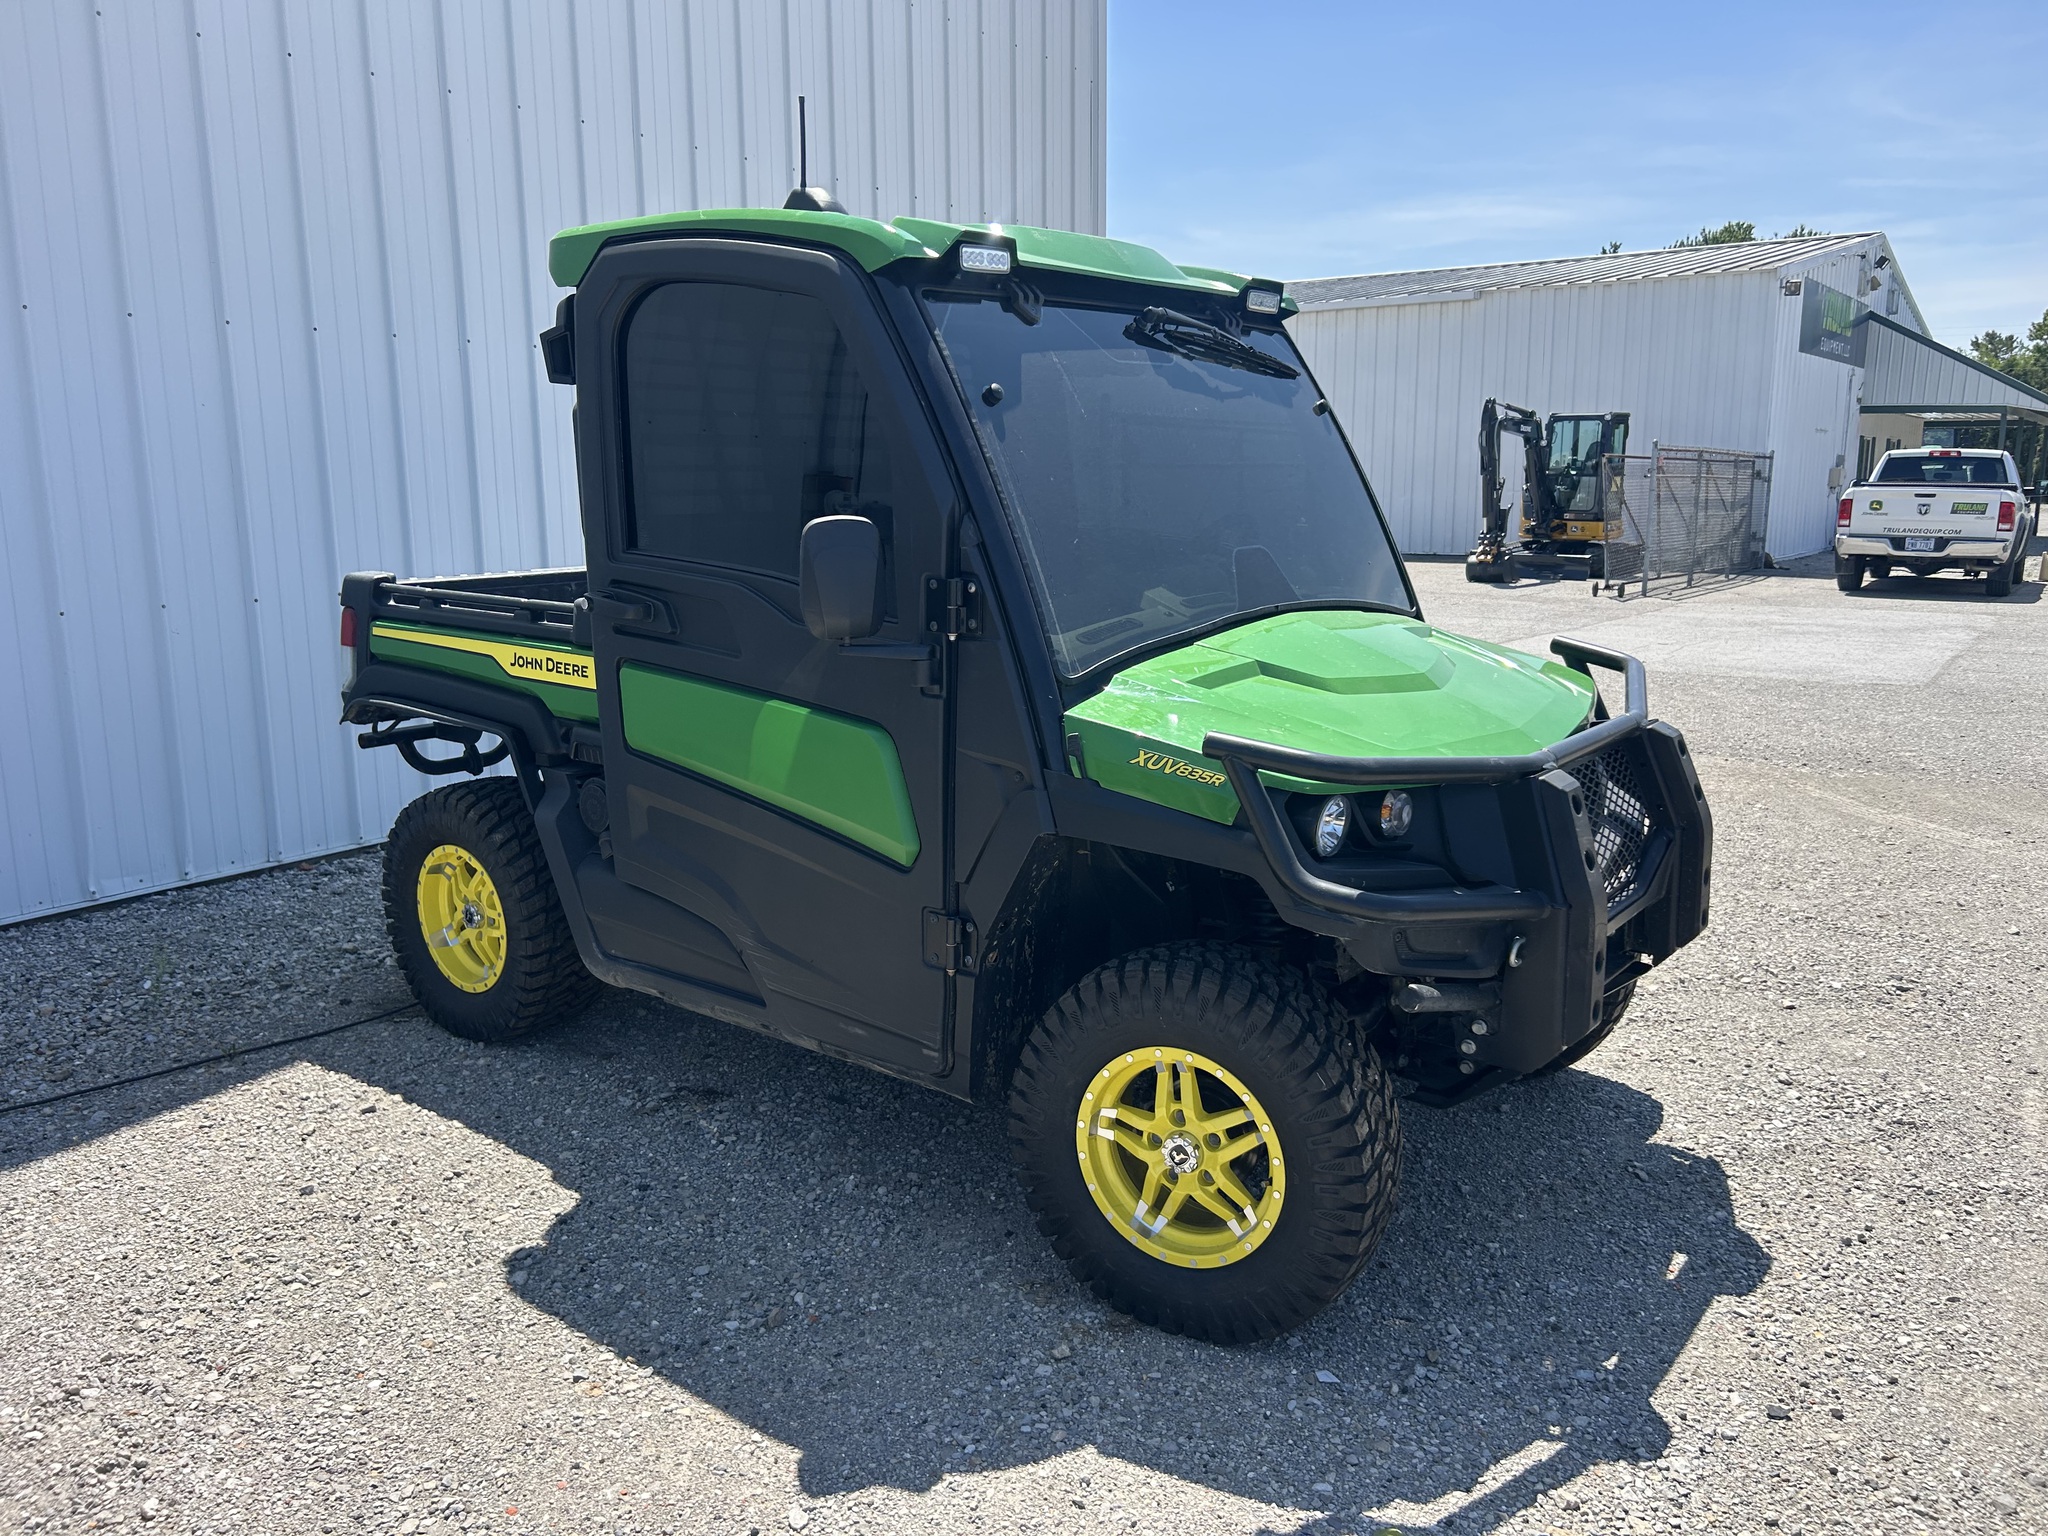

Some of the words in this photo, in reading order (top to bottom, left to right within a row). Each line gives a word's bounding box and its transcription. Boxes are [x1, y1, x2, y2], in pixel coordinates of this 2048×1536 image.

[1953, 503, 1986, 511] TRULAND
[1882, 527, 1962, 535] TRULANDEQUIP.COM
[510, 652, 543, 671] JOHN
[546, 657, 589, 679] DEERE
[1129, 749, 1226, 787] XUV835R
